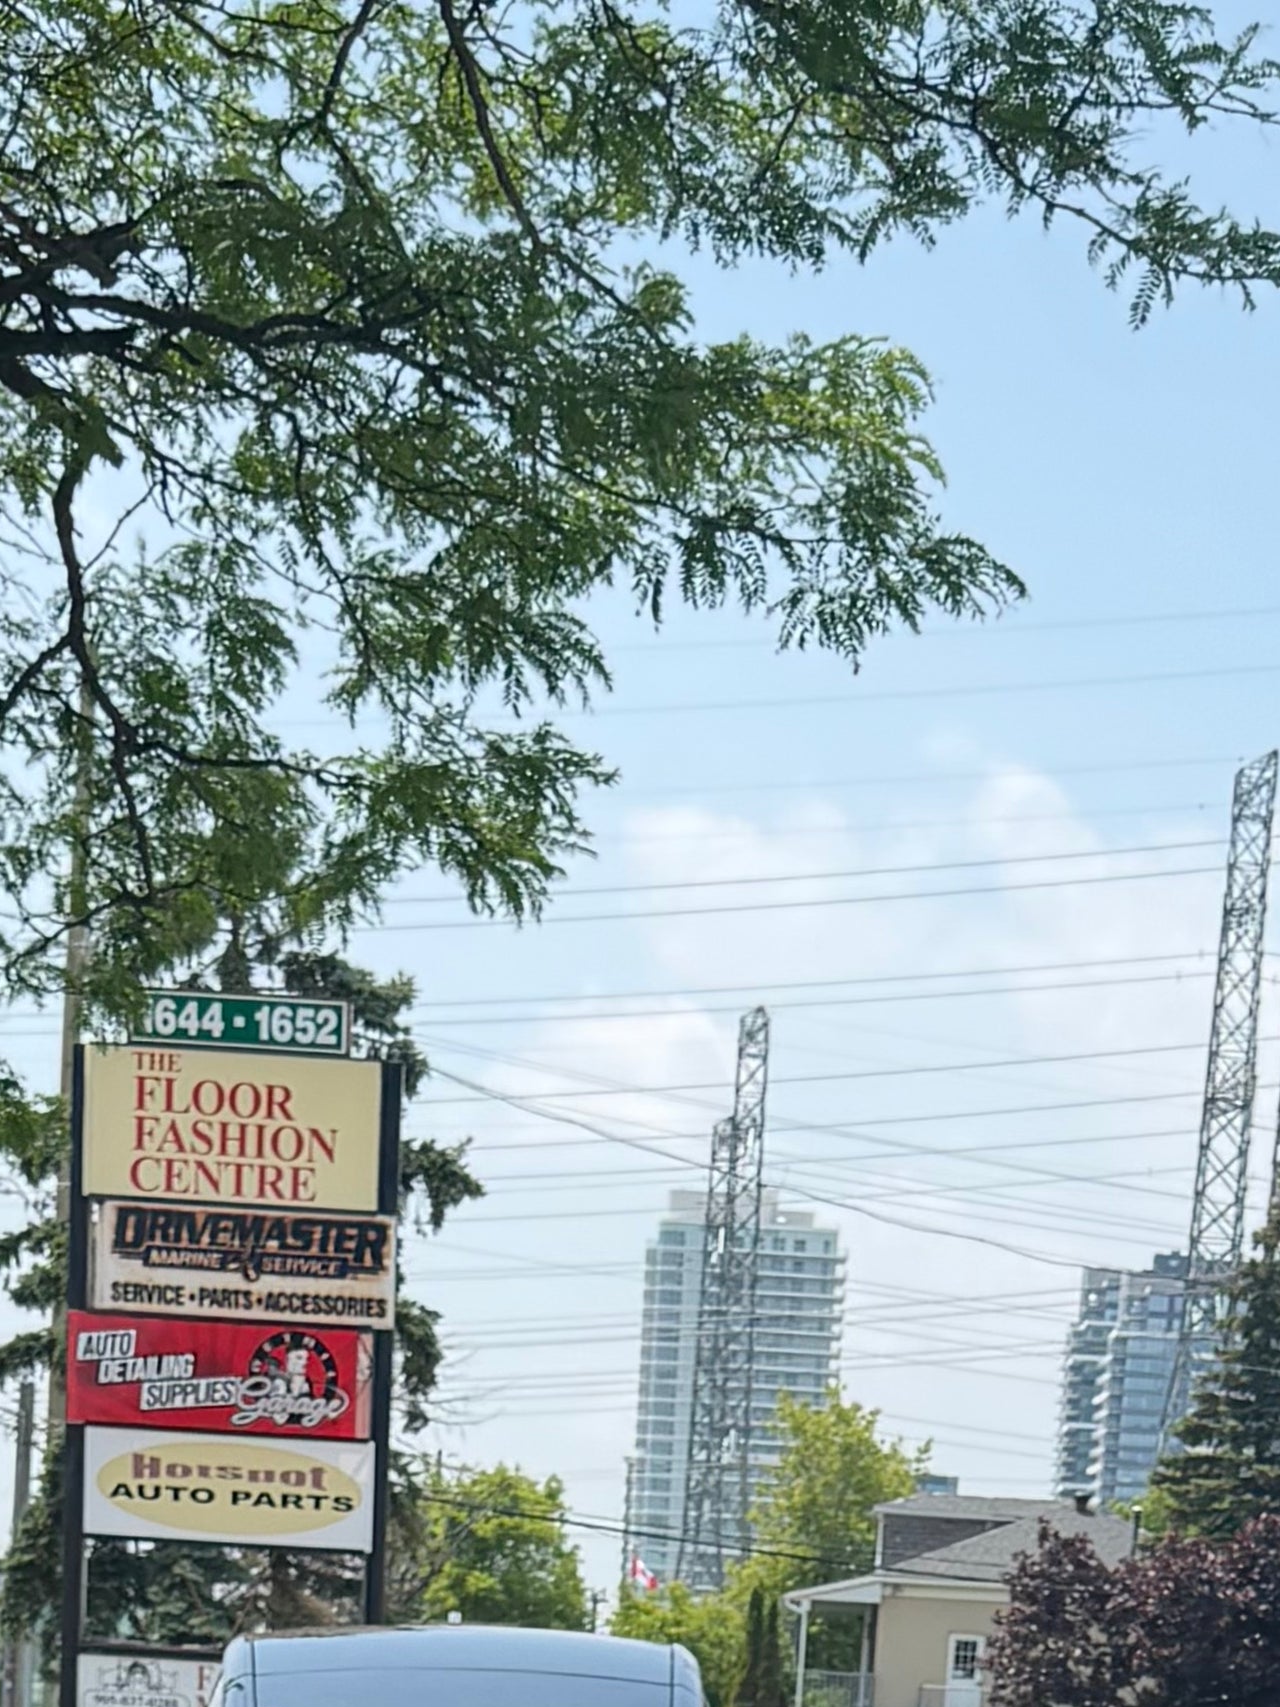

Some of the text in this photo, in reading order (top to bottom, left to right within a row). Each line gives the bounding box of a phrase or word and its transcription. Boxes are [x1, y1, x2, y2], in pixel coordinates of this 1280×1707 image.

[143, 998, 225, 1038] 1644
[254, 1005, 338, 1045] 1652
[132, 1051, 182, 1073] THE
[133, 1076, 294, 1122] FLOOR
[133, 1116, 338, 1163] FASHION
[130, 1157, 316, 1202] CENTRE
[112, 1206, 391, 1270] DRIVEMASTER
[148, 1249, 342, 1276] MARINE SERVICE
[111, 1281, 388, 1318] SERVICE PARTS ACCESSORIES
[82, 1332, 133, 1356] AUTO
[101, 1355, 195, 1383] DETAILING
[146, 1380, 236, 1406] SUPPLIES
[231, 1376, 349, 1427] Garage
[131, 1453, 328, 1491] Hotspot
[110, 1483, 354, 1513] AUTO PARTS
